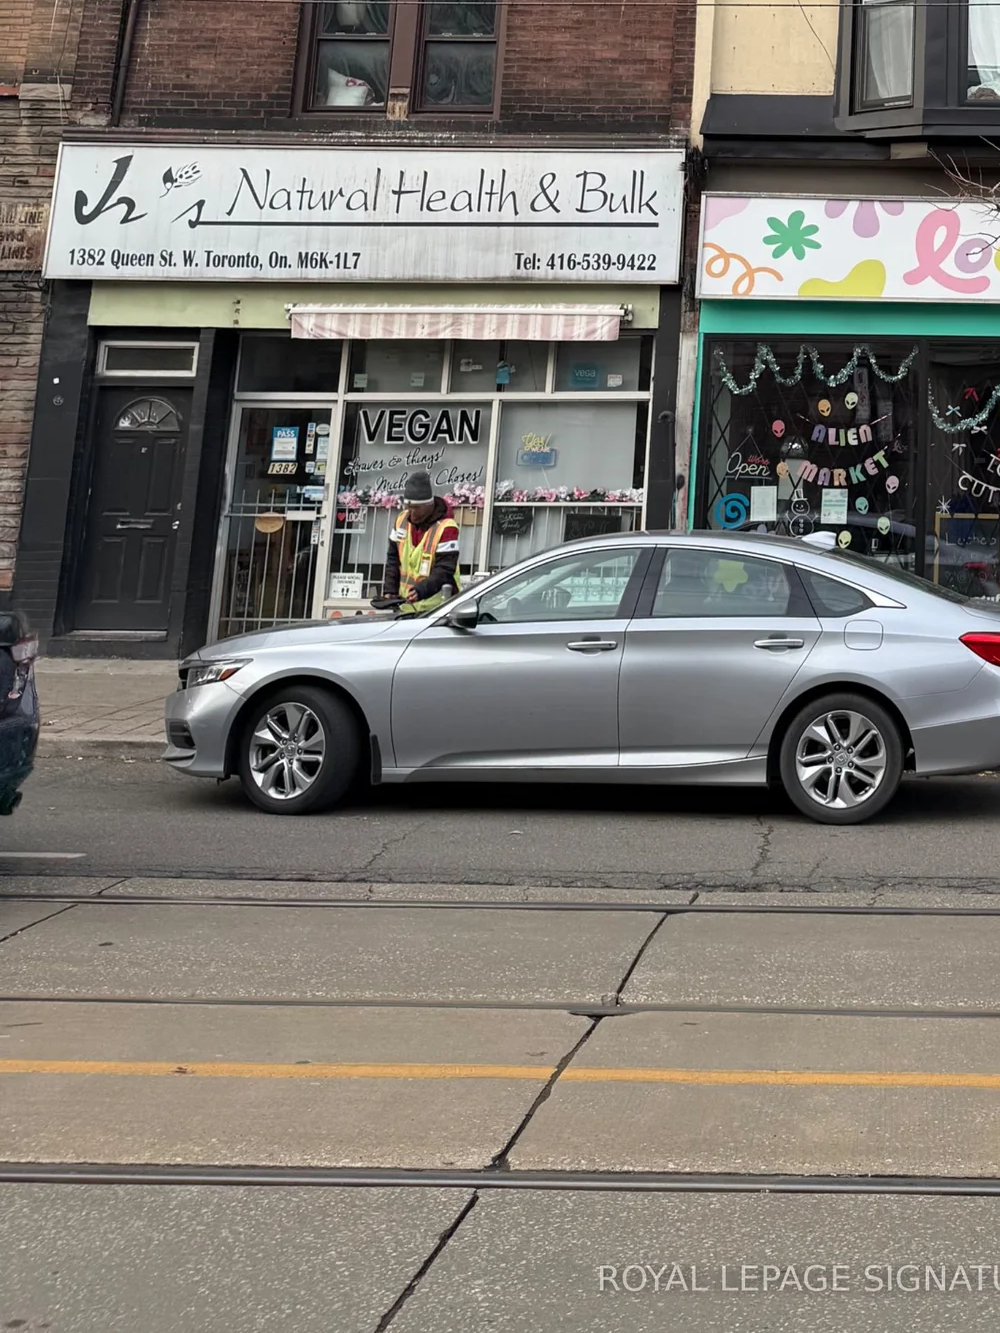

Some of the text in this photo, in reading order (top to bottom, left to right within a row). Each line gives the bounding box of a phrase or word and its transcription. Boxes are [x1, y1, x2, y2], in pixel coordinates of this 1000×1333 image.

[226, 167, 381, 216] Natural
[392, 168, 519, 216] Health
[530, 172, 561, 214] &
[575, 169, 659, 216] Bulk
[68, 248, 361, 272] 1382 Queen St. W. Toronto, On. M6K-1L7
[514, 252, 657, 271] Tel: 416-539-9422
[277, 430, 295, 438] PASS
[359, 408, 482, 444] VEGAN
[810, 423, 873, 446] ALIEN
[270, 463, 297, 473] 1382
[405, 446, 446, 470] things!
[726, 451, 771, 480] Open
[796, 450, 889, 486] MARKET
[434, 466, 484, 487] Choses!
